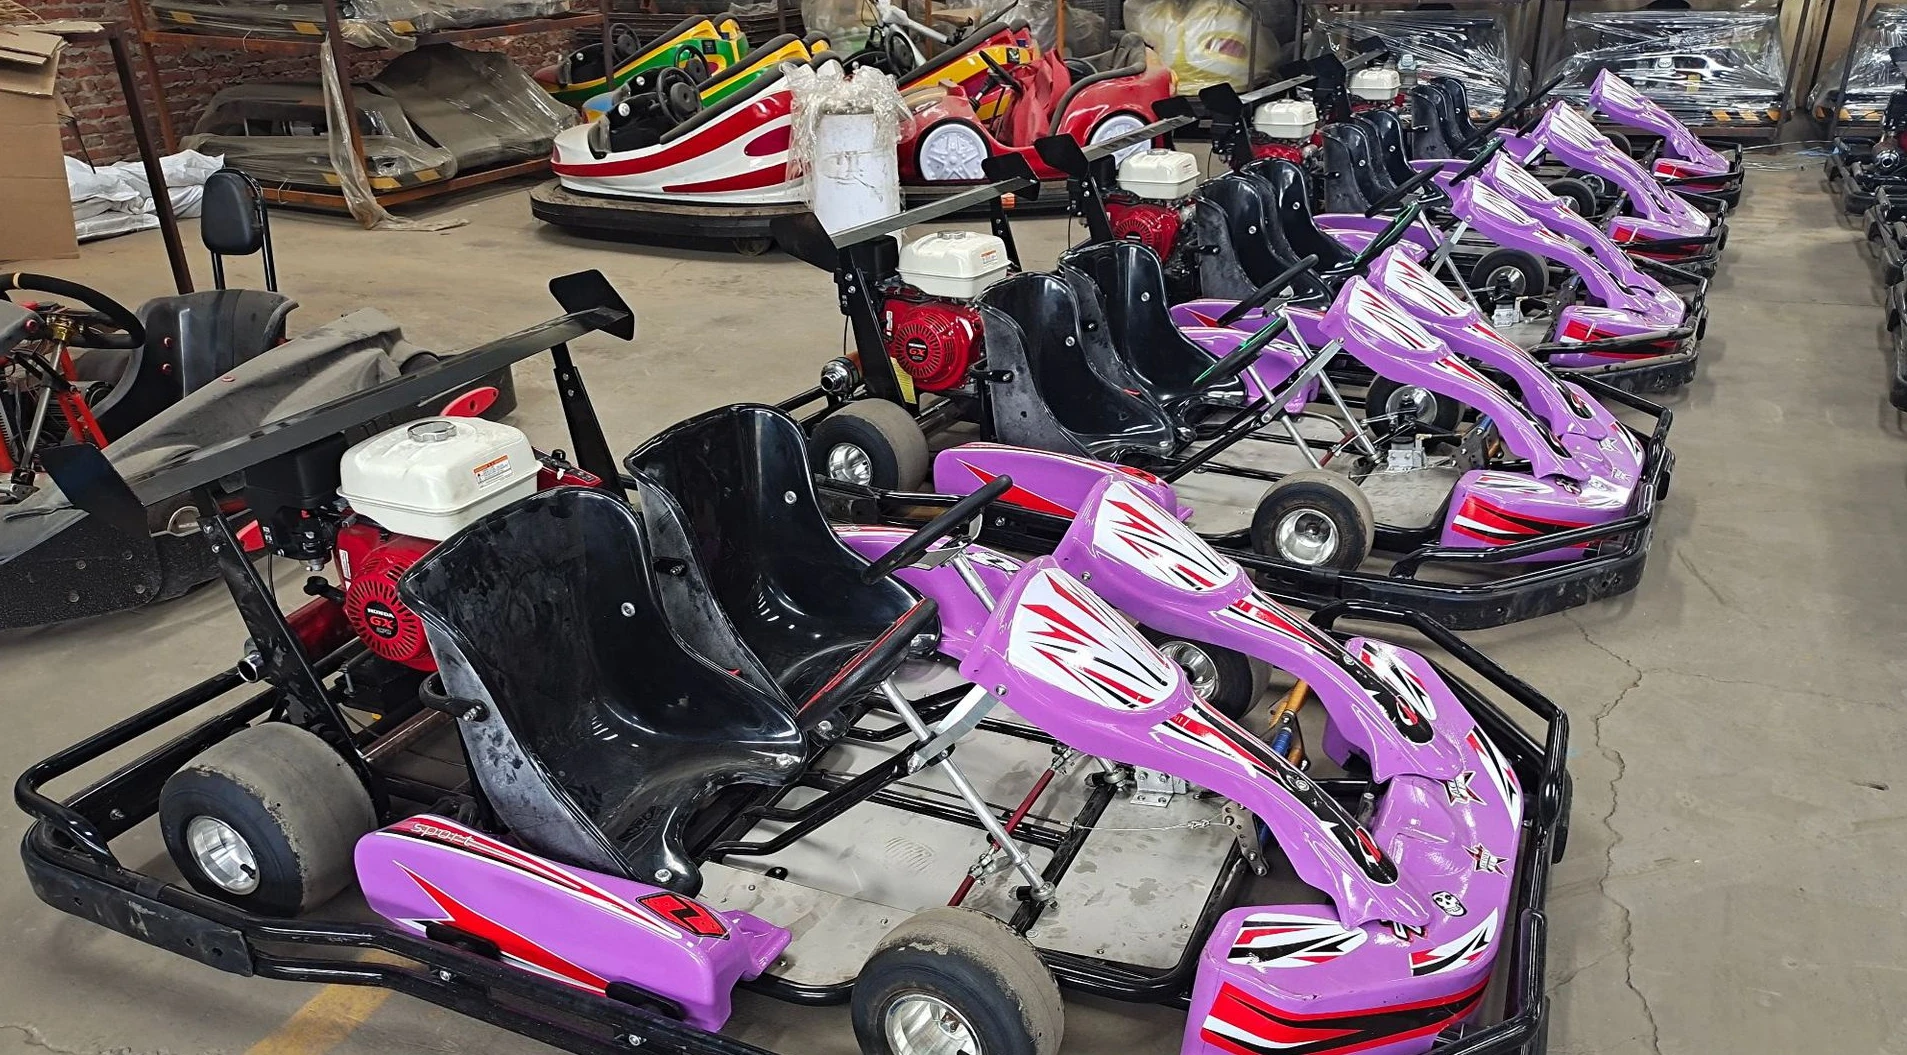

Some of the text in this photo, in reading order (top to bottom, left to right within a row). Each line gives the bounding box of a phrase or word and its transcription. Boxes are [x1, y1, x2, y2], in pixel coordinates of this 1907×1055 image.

[909, 348, 925, 356] GX
[367, 608, 395, 618] HONDA
[370, 616, 393, 629] GX
[410, 822, 474, 846] sport
